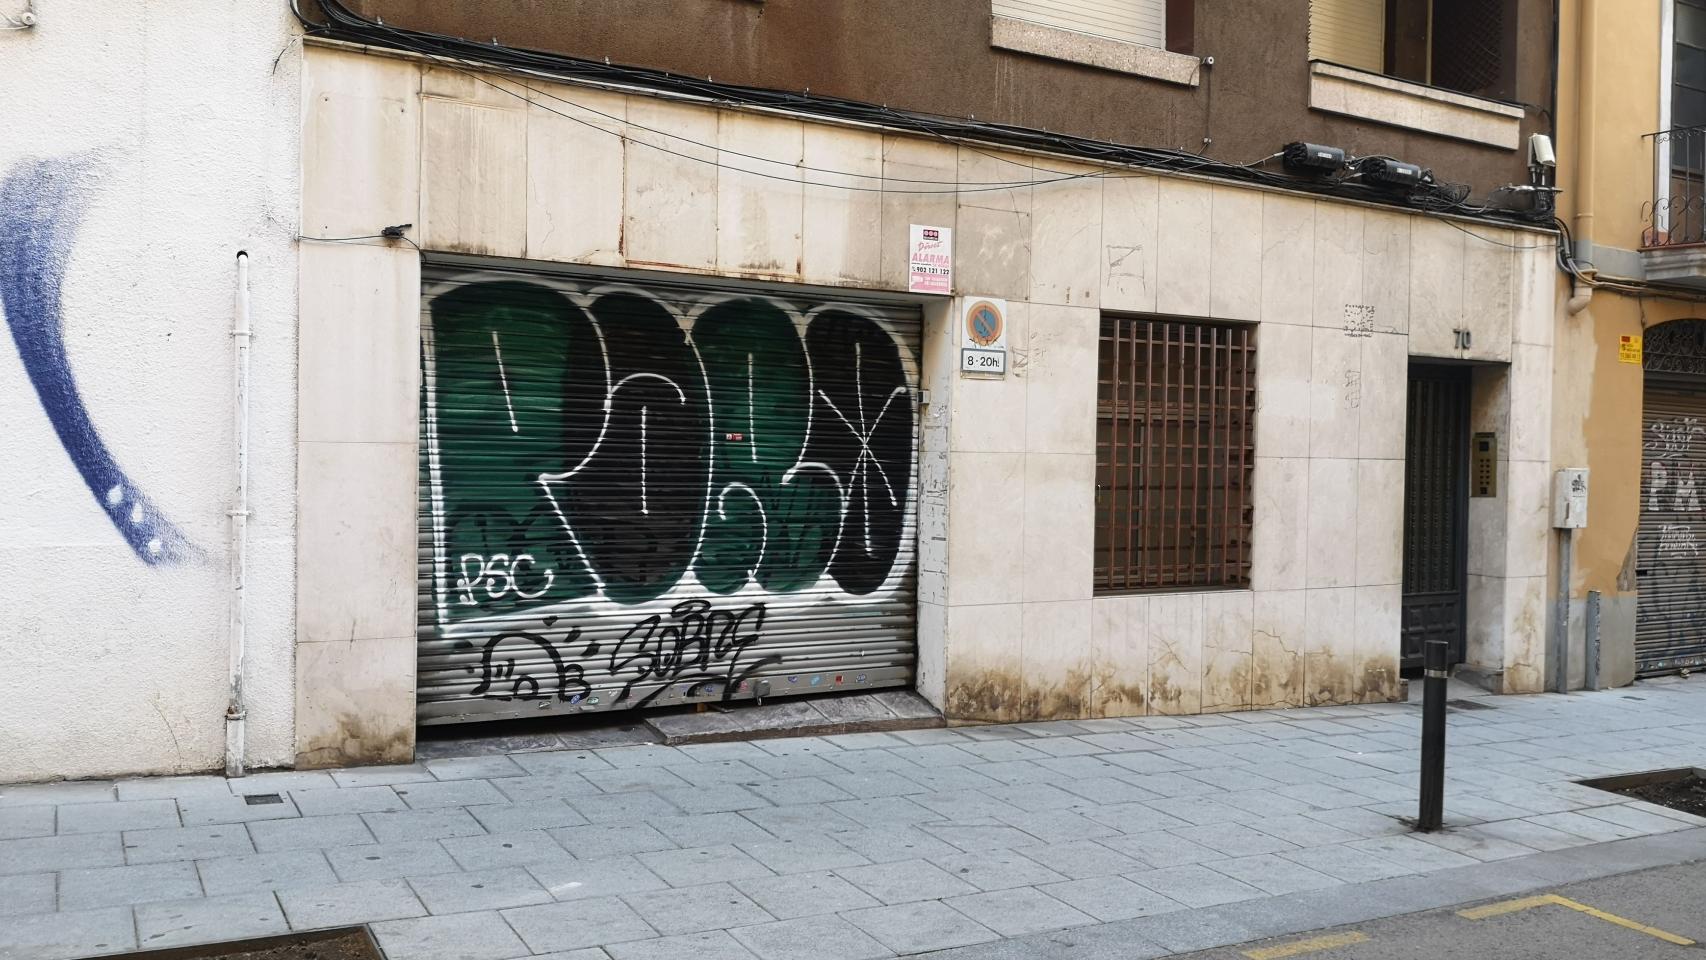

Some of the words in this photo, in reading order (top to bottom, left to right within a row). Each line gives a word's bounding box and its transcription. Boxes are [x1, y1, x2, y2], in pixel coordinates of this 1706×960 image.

[912, 253, 950, 265] ALARMA
[1452, 328, 1472, 349] 70
[456, 553, 555, 606] PSC
